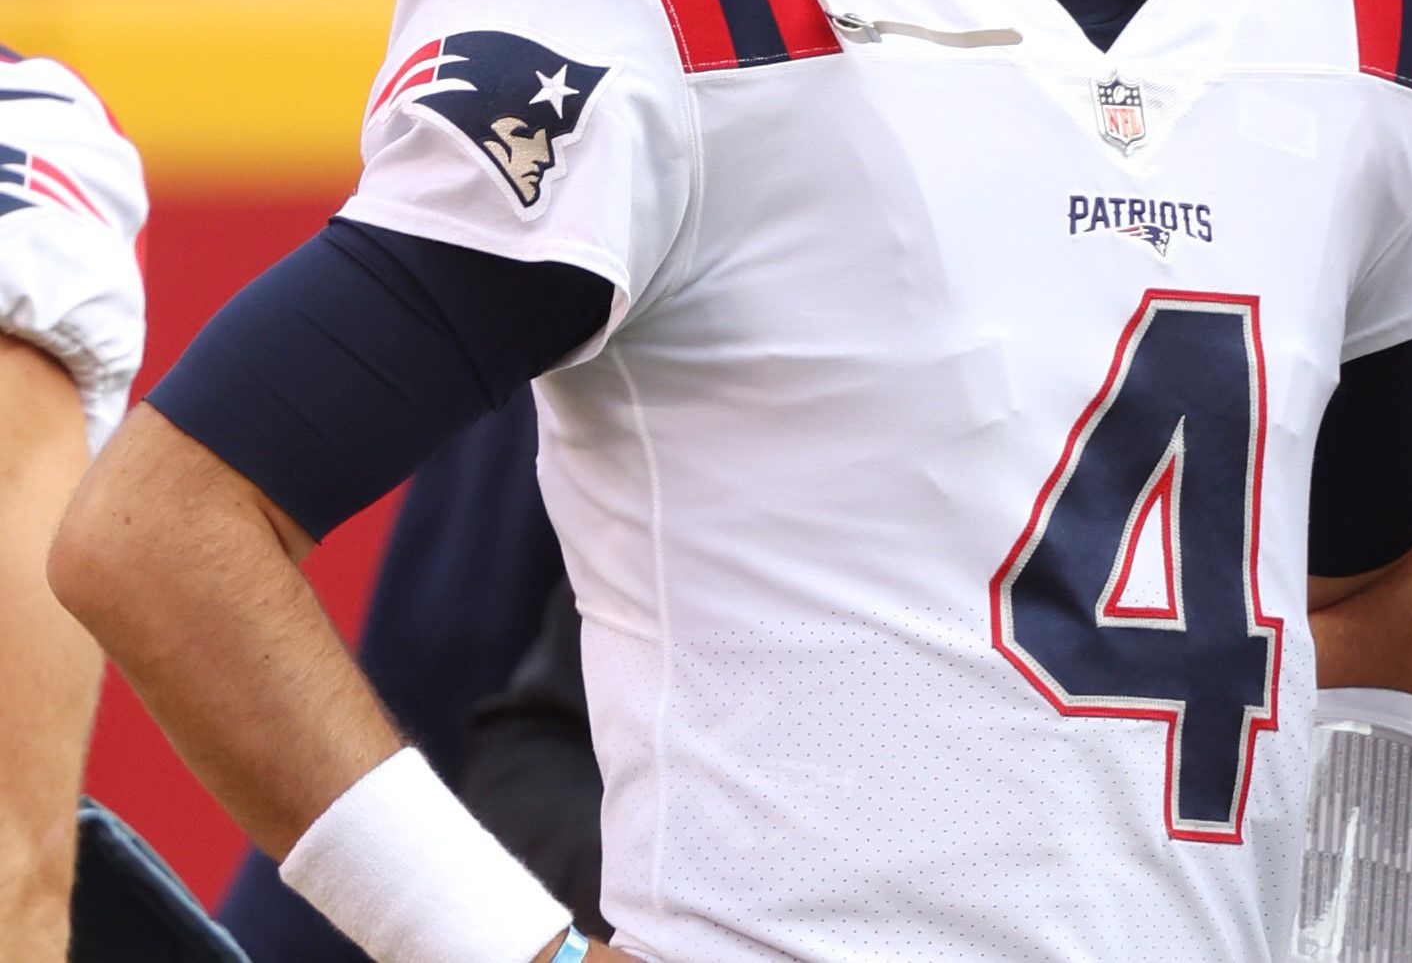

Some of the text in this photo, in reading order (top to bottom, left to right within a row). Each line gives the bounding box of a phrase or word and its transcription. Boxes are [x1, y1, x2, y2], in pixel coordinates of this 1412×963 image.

[1104, 107, 1143, 138] NFL
[1067, 195, 1213, 243] PATRIOTS
[990, 288, 1283, 845] 4
